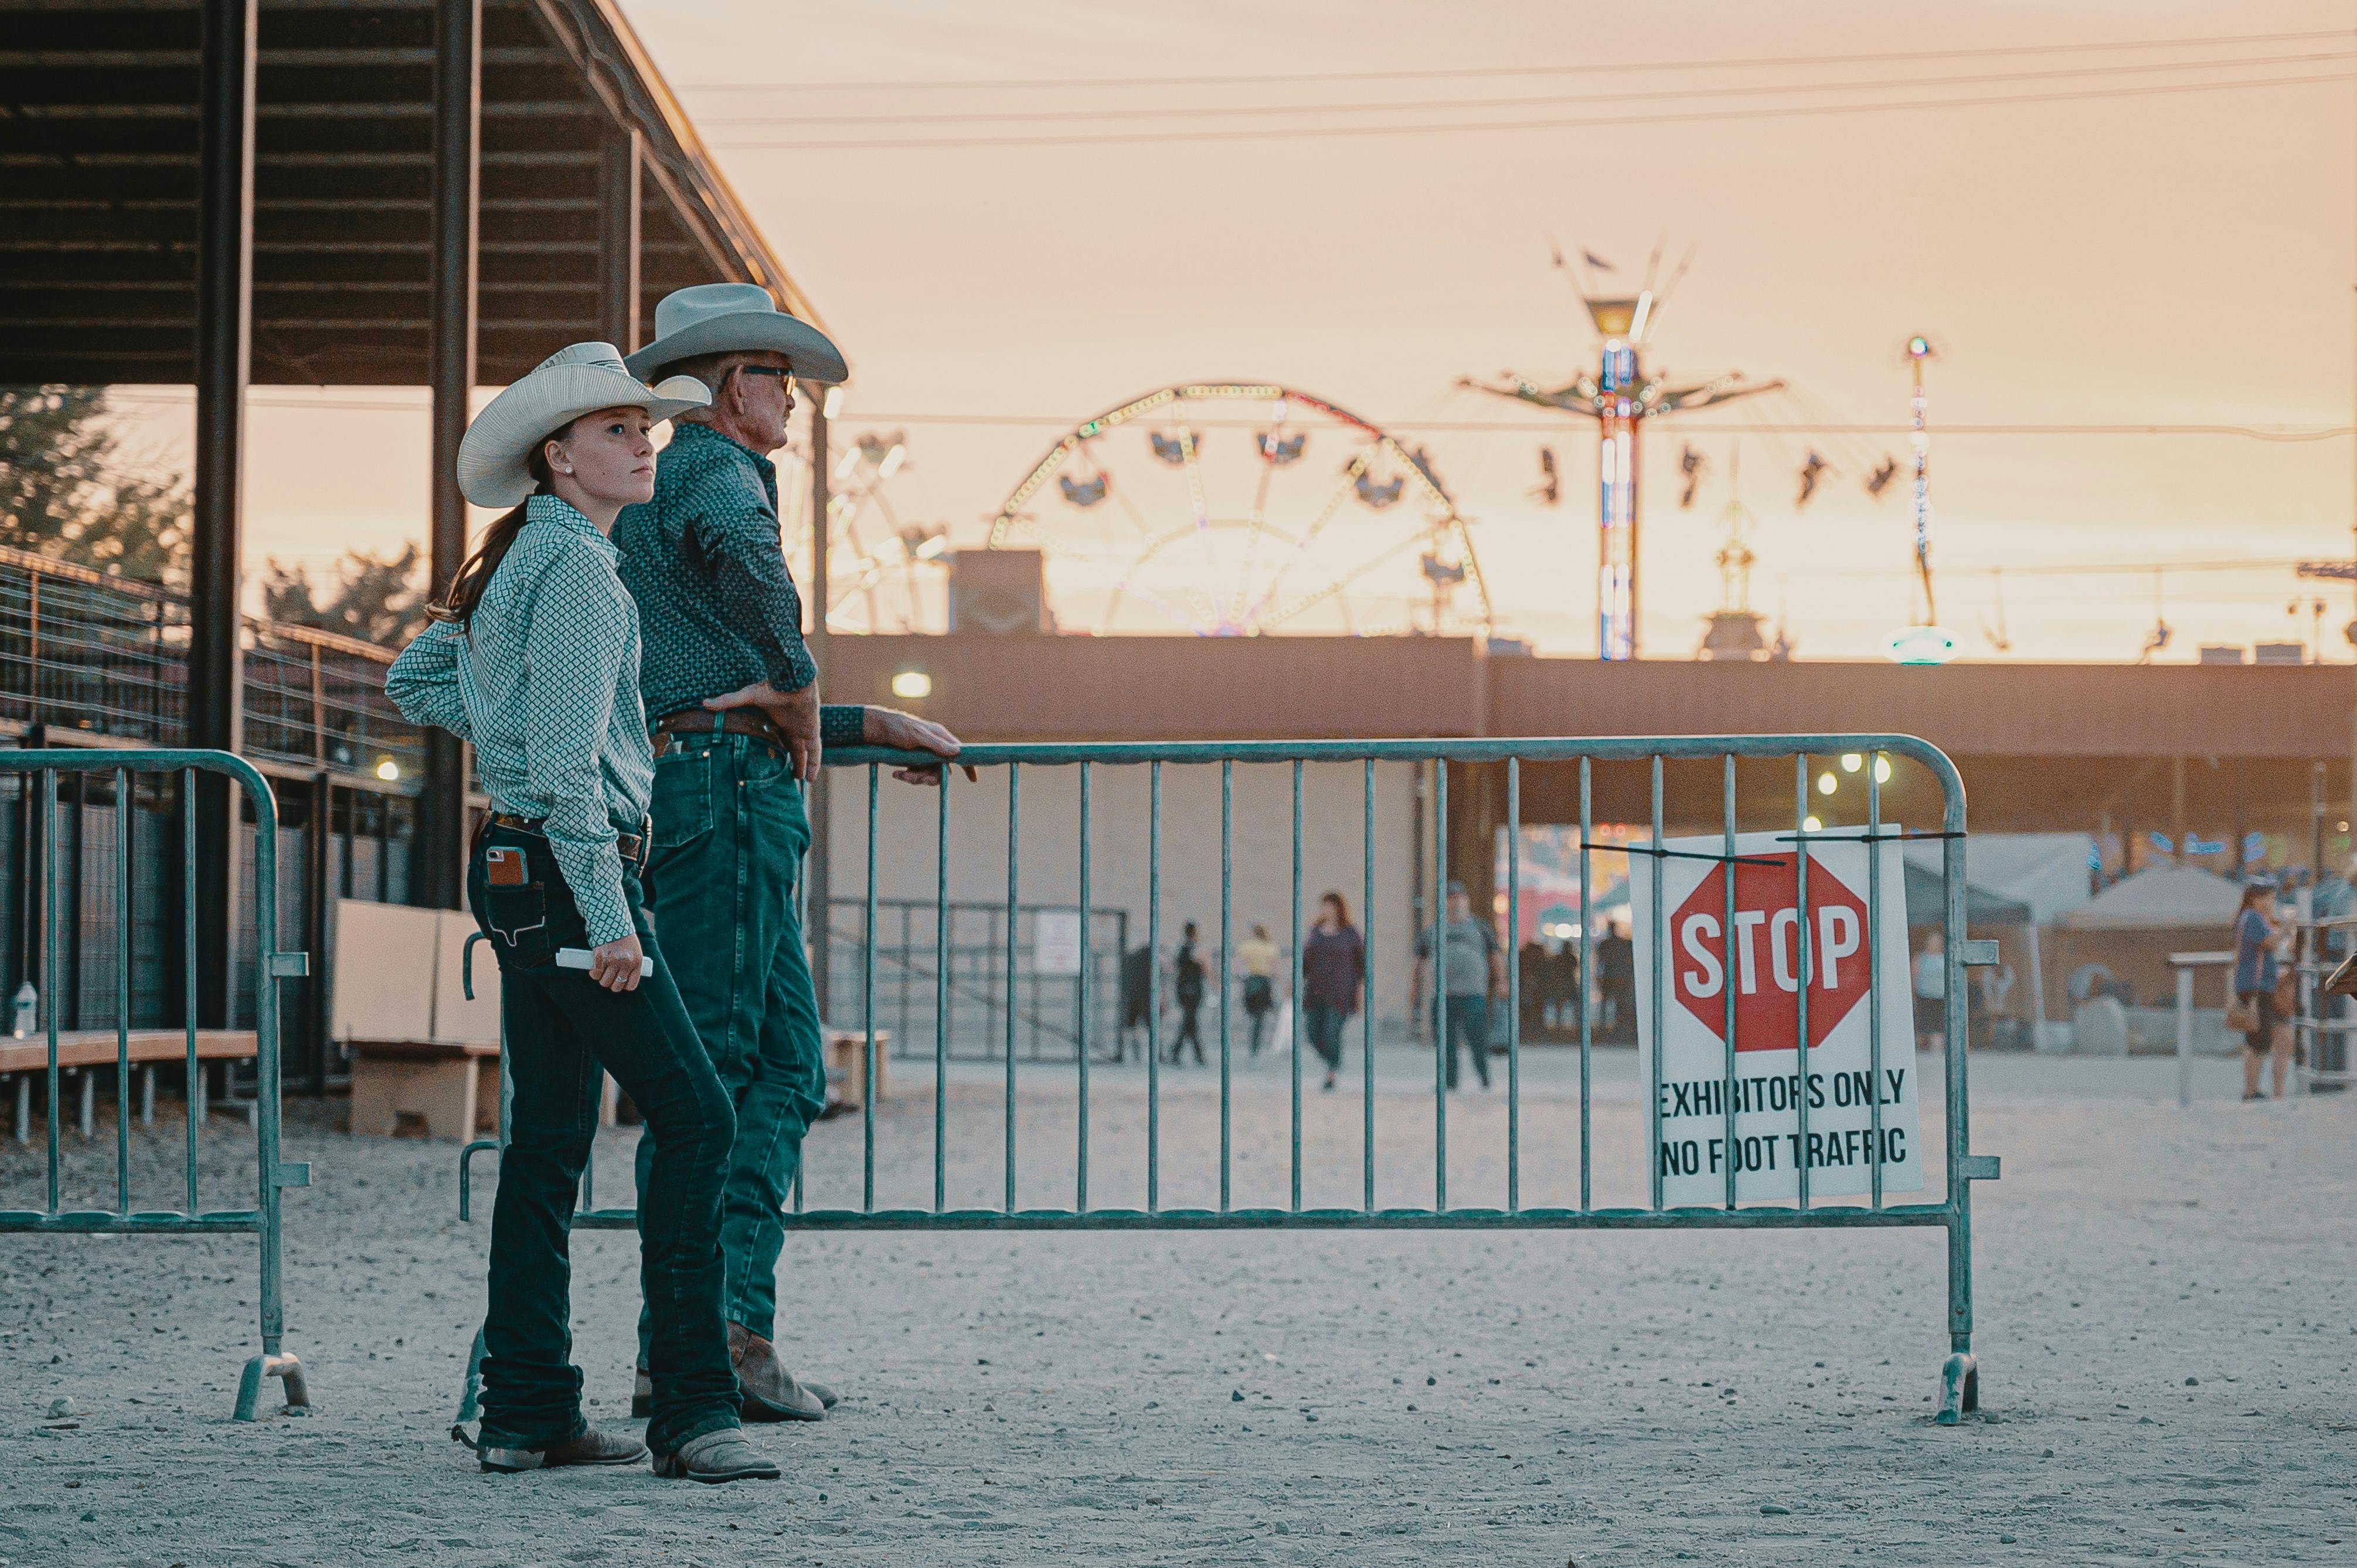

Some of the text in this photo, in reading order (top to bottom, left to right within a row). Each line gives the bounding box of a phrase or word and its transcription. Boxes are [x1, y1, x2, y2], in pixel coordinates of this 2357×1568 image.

[1681, 905, 1860, 998] STOP
[1661, 1140, 1699, 1176] NO
[1787, 1127, 1906, 1169] TRAFFIC
